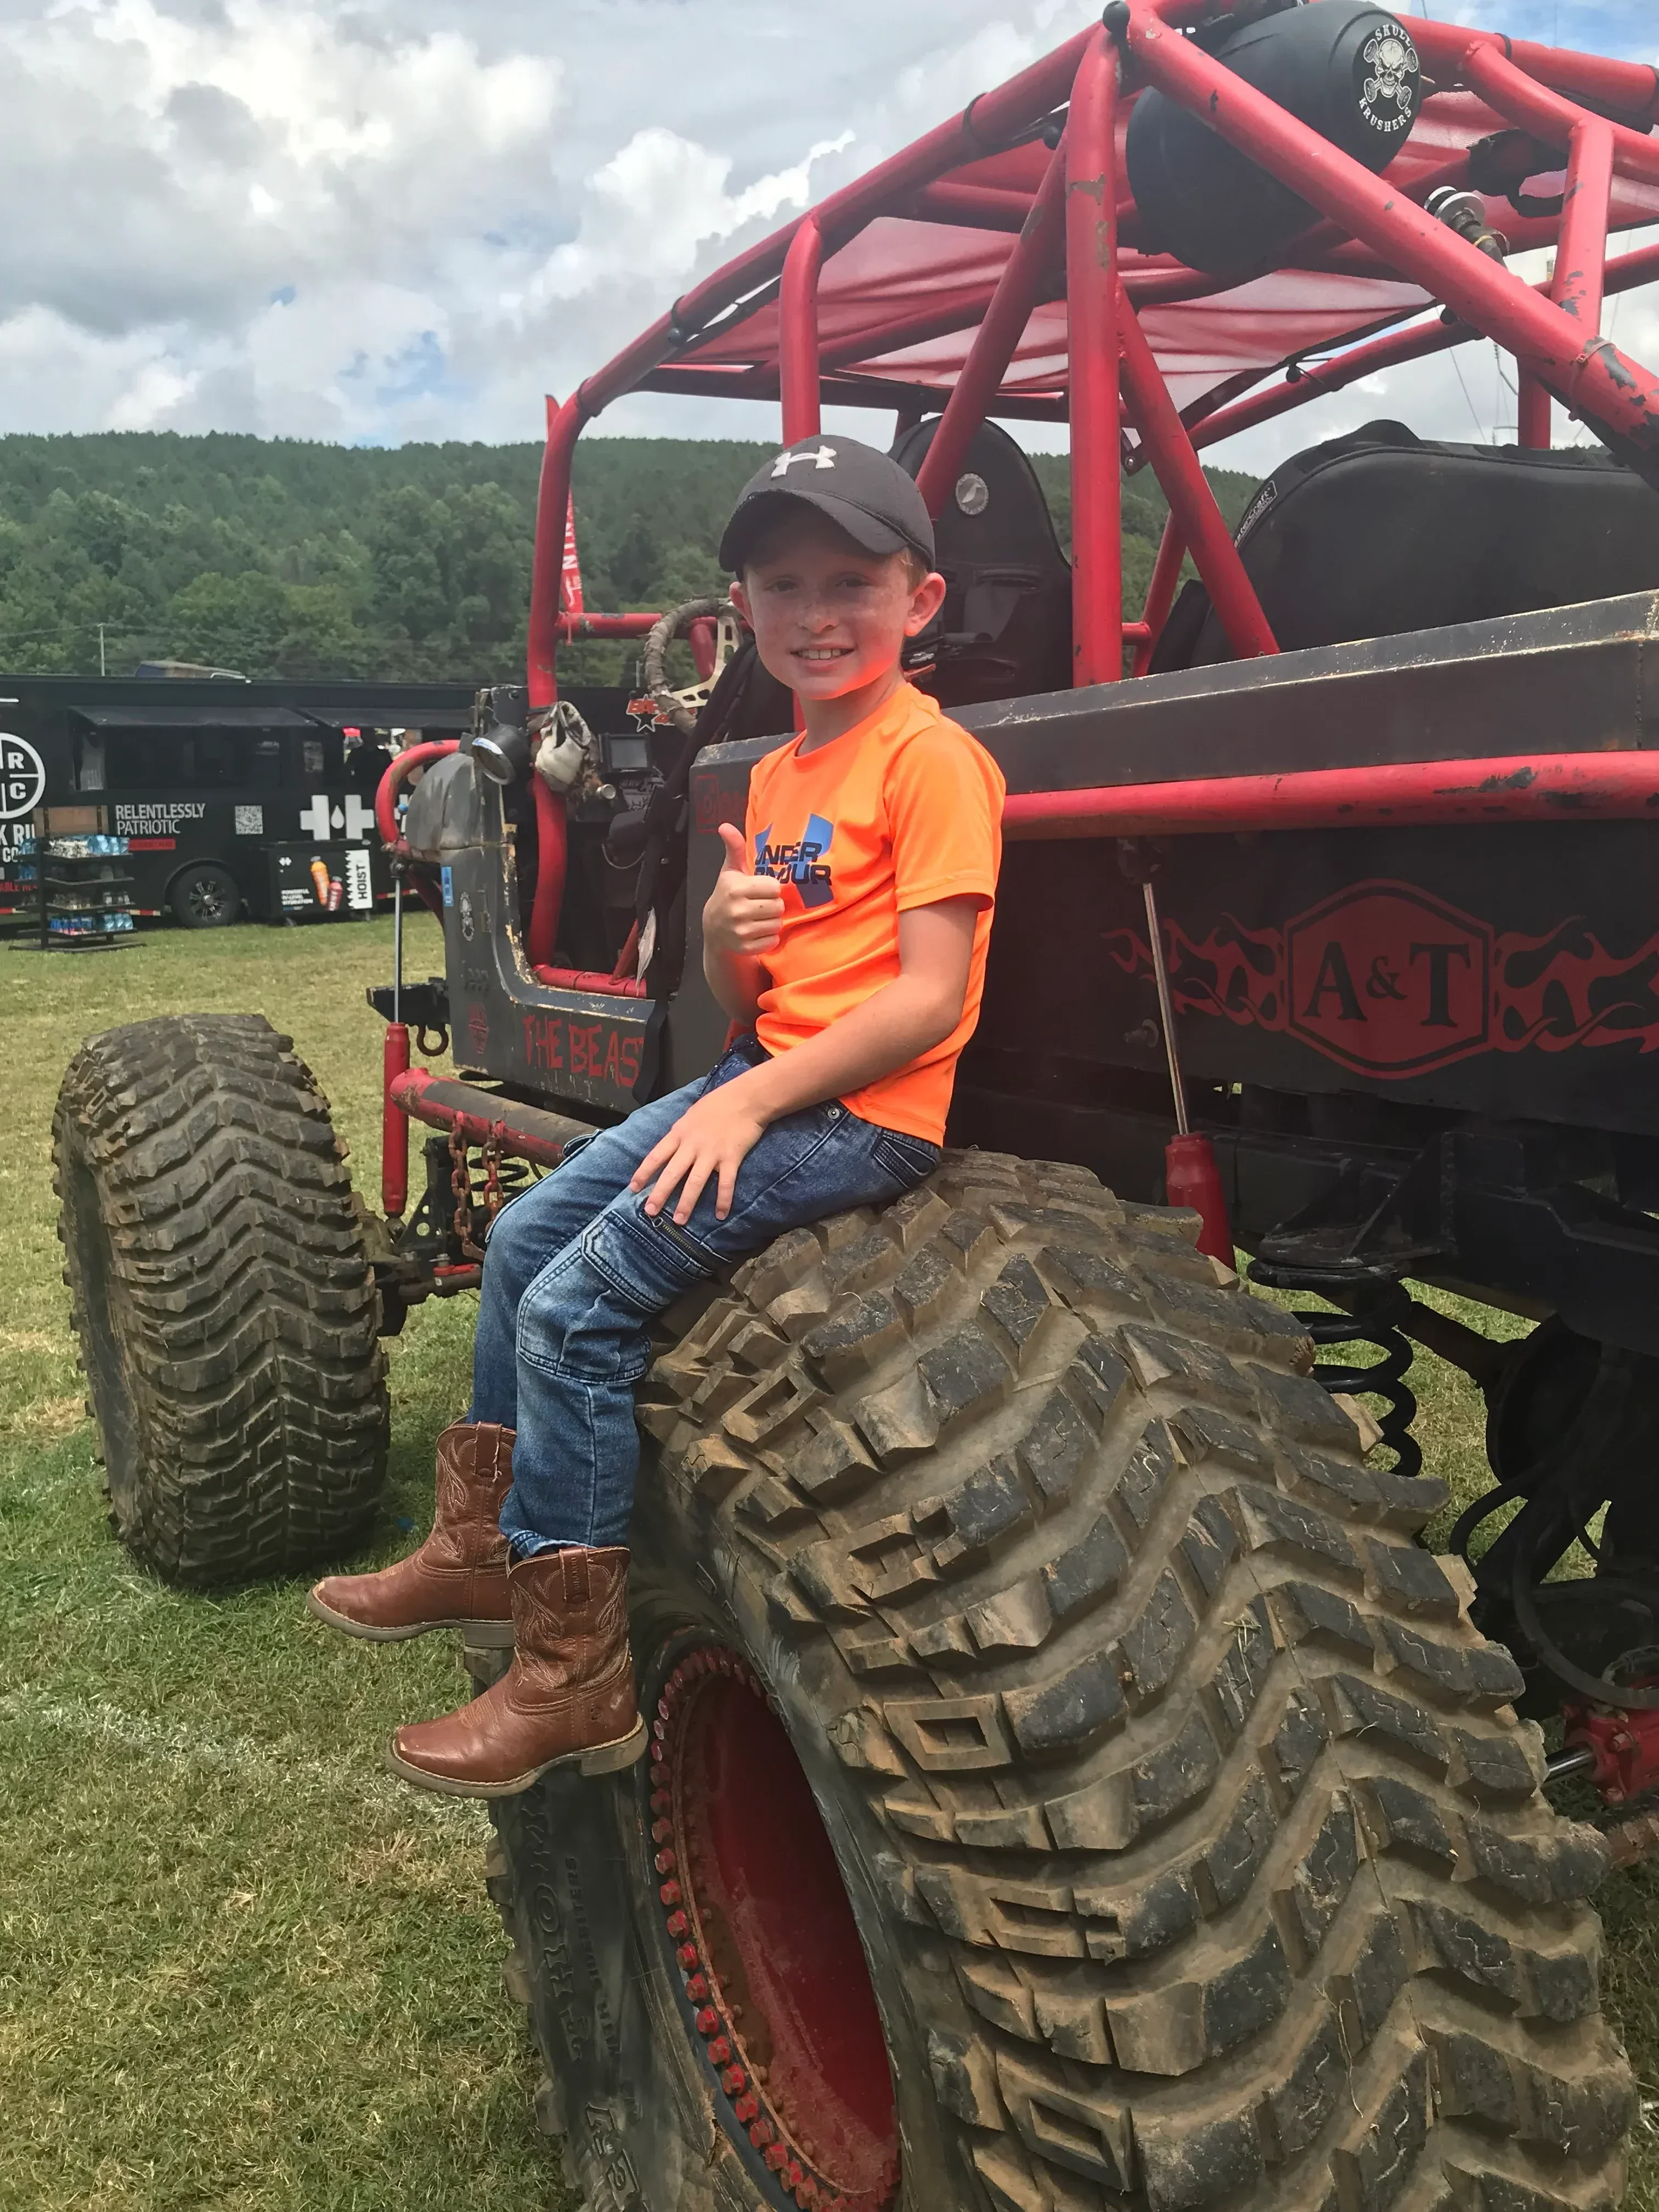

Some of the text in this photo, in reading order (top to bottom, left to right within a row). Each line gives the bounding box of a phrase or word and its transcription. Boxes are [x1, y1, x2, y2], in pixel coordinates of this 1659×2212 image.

[1375, 24, 1414, 47] SKULL
[1358, 97, 1412, 132] KRUSHERS
[115, 803, 206, 820] RELENTLESSLY
[117, 819, 181, 836] PATRIOTIC
[357, 865, 368, 900] HOIST
[522, 1014, 563, 1069] THE
